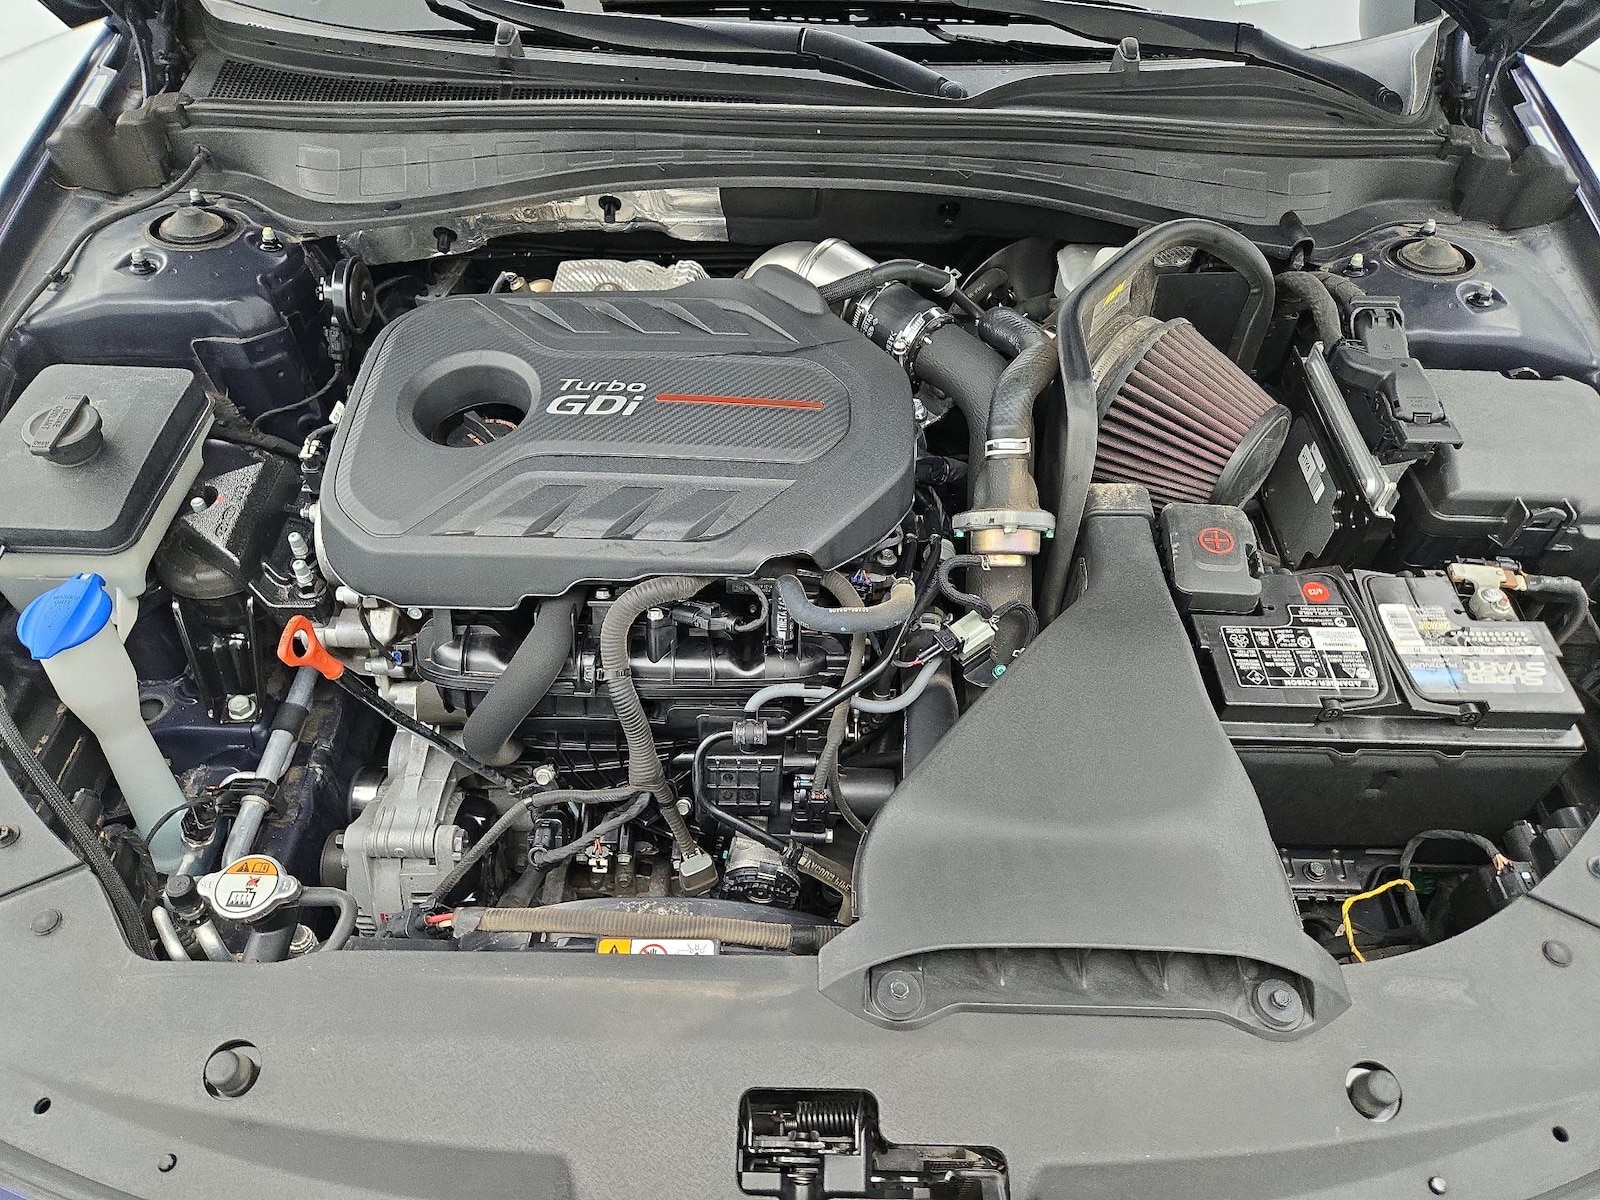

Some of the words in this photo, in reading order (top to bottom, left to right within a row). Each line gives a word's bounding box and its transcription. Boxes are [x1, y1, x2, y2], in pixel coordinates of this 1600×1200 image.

[560, 378, 647, 392] Turbo
[546, 395, 645, 416] GDi
[1464, 661, 1547, 677] START
[1467, 674, 1544, 686] SUPER
